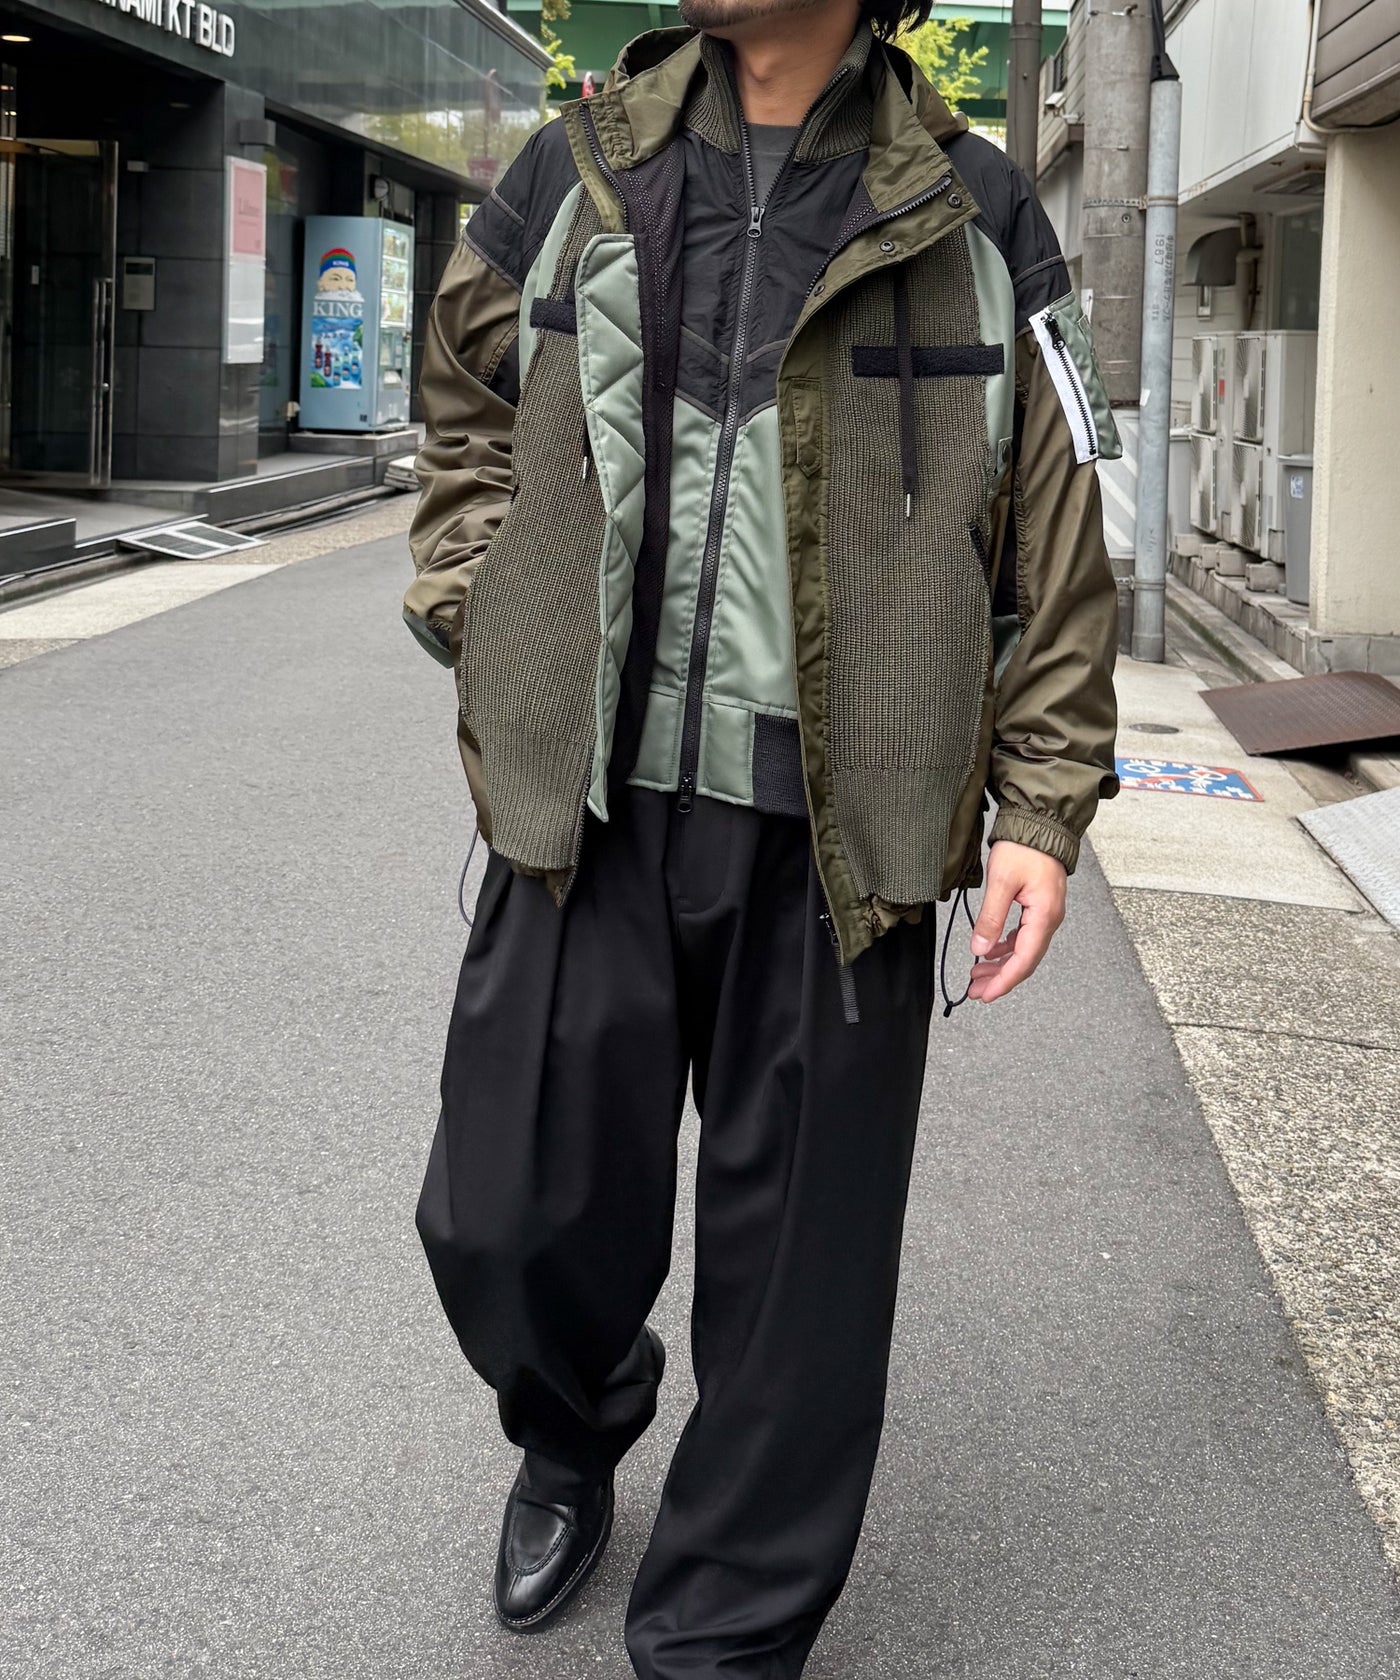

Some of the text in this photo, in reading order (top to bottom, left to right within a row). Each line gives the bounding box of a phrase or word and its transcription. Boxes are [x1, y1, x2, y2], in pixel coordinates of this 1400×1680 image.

[166, 0, 195, 39] KT
[197, 4, 235, 57] BLD
[1154, 234, 1165, 265] 1987
[312, 302, 363, 317] KING
